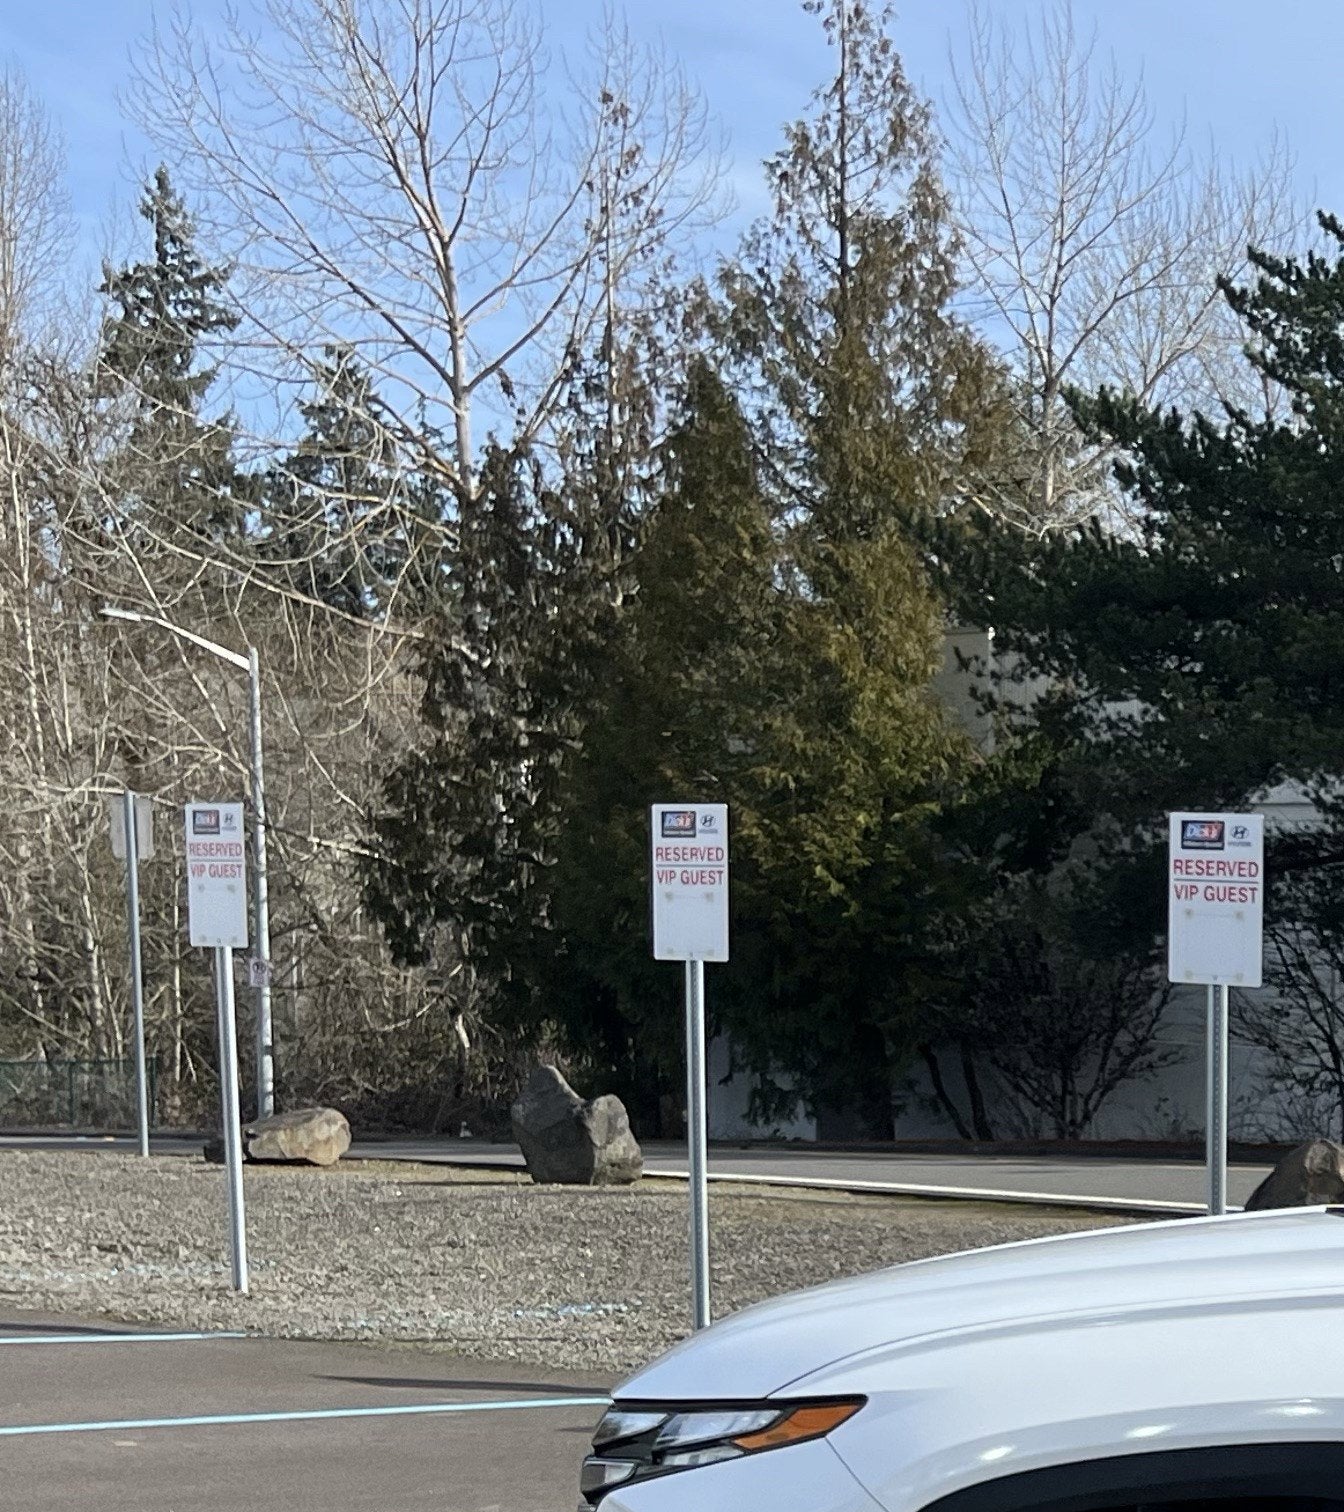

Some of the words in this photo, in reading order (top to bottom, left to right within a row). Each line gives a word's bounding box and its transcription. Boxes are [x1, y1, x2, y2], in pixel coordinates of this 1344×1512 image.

[189, 842, 242, 857] RESERVED
[655, 847, 724, 862] RESERVED
[190, 864, 205, 878] VIP
[208, 863, 242, 878] GUEST
[1174, 859, 1258, 877] RESERVED
[656, 870, 676, 884] VIP
[680, 870, 724, 885] GUEST
[1174, 885, 1198, 901] VIP
[1204, 886, 1258, 904] GUEST
